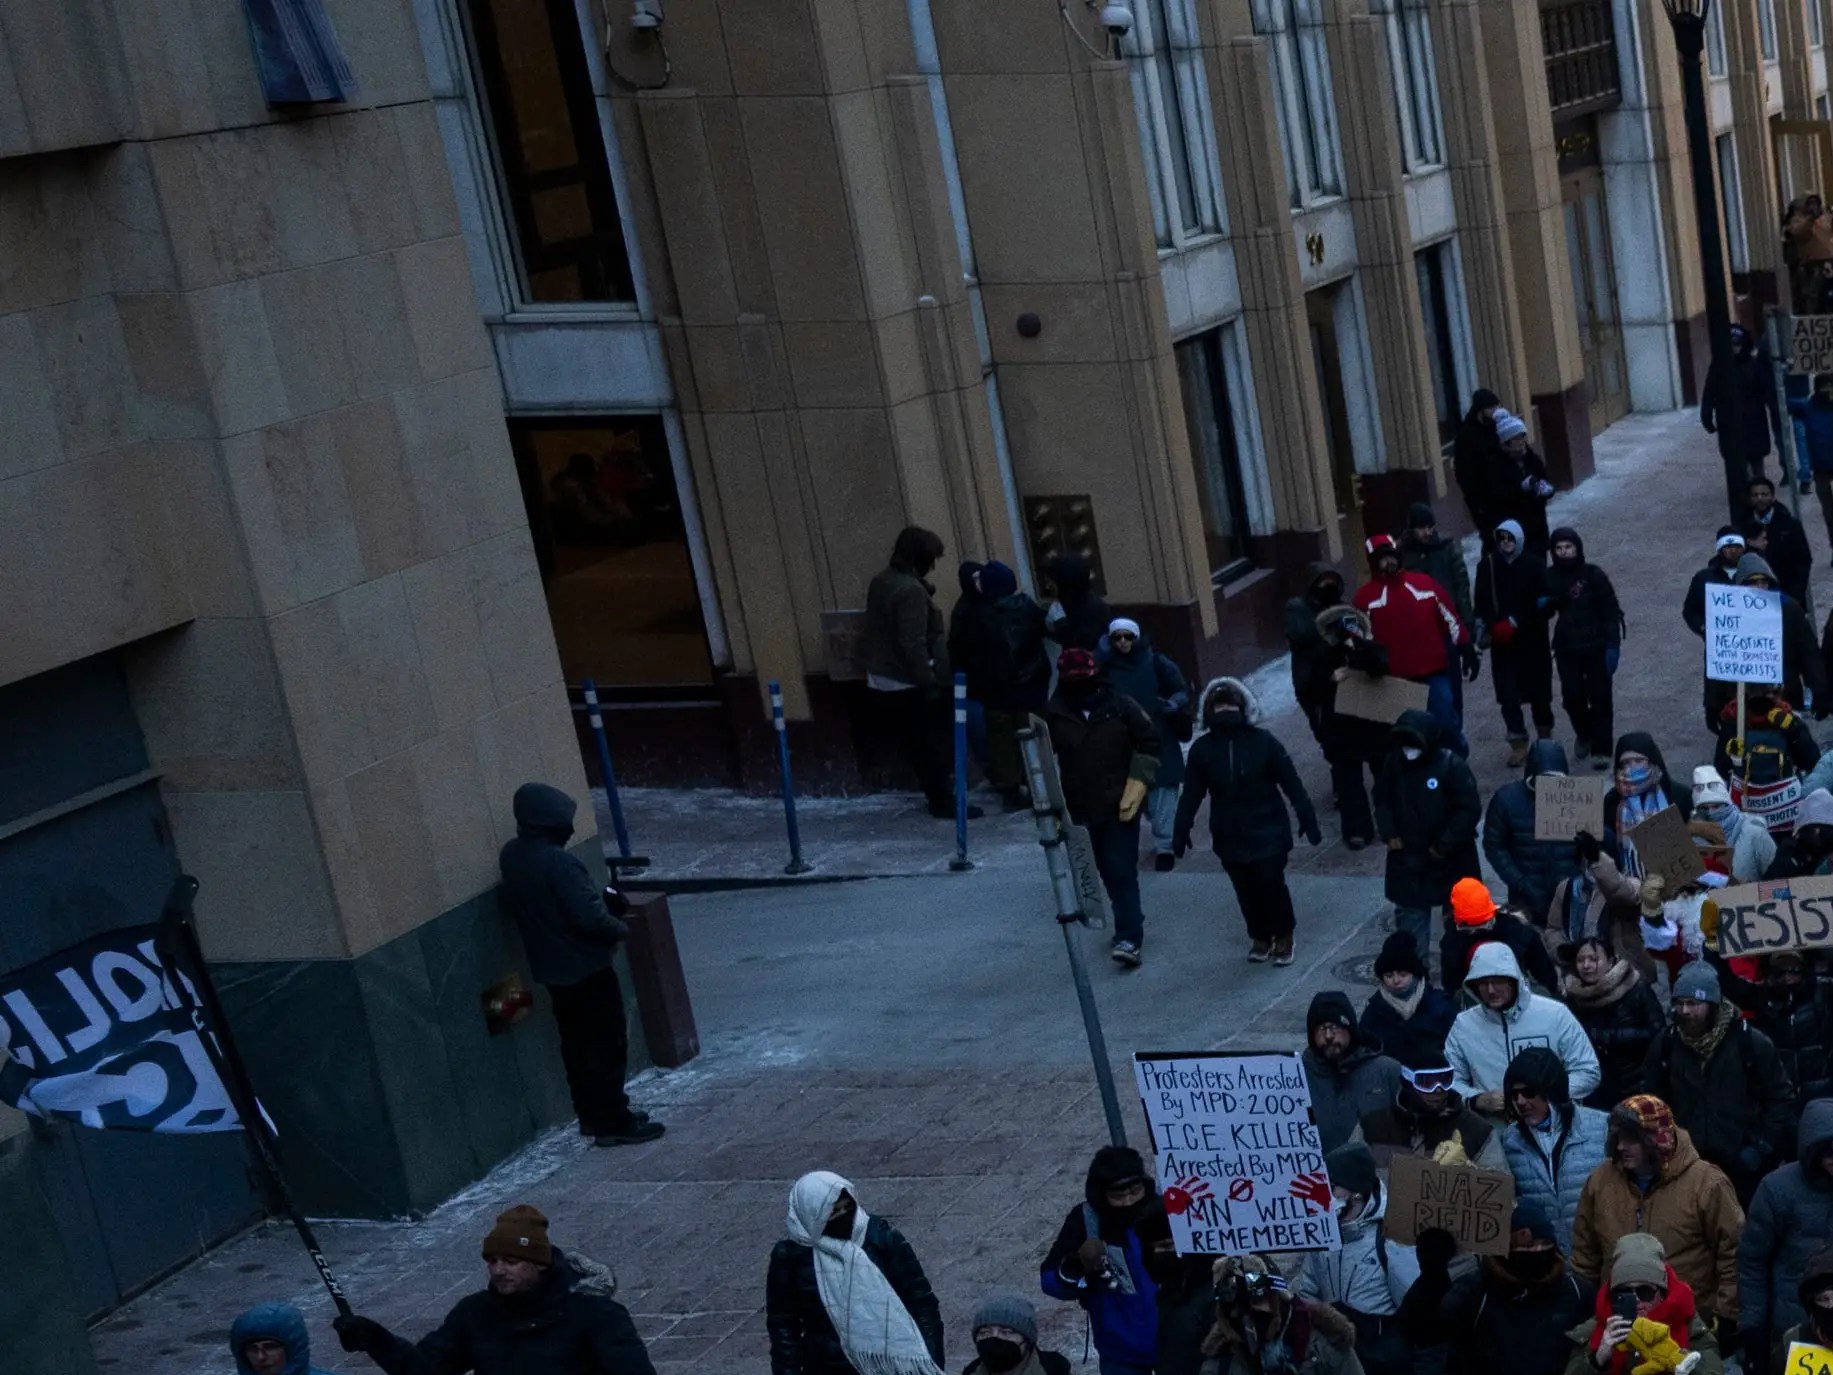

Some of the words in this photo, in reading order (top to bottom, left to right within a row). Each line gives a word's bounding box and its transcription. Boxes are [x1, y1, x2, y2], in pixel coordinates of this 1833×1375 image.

[1711, 592, 1737, 609] WE
[1744, 596, 1768, 611] DO
[1715, 616, 1740, 630] NOT
[1715, 635, 1777, 653] NEGOTIATE
[1715, 663, 1777, 681] TERRORISTS
[1544, 792, 1595, 806] HUMAN
[1557, 780, 1577, 791] NO
[1746, 793, 1783, 811] DISSENT
[1786, 788, 1797, 801] IS
[1559, 808, 1575, 820] IS
[1142, 1064, 1241, 1119] Protesters
[1238, 1062, 1305, 1111] Arrested
[1161, 1089, 1189, 1123] By
[1190, 1091, 1238, 1119] MPD:
[1246, 1092, 1311, 1119] 200+
[1230, 1118, 1318, 1150] KILLERS
[1163, 1150, 1248, 1183] Arrested
[1248, 1154, 1277, 1187] By
[1277, 1149, 1322, 1178] MPD
[1420, 1168, 1503, 1212] NAZ
[1184, 1199, 1233, 1231] MN
[1412, 1201, 1500, 1243] REID
[1190, 1217, 1333, 1253] REMEMBER!!
